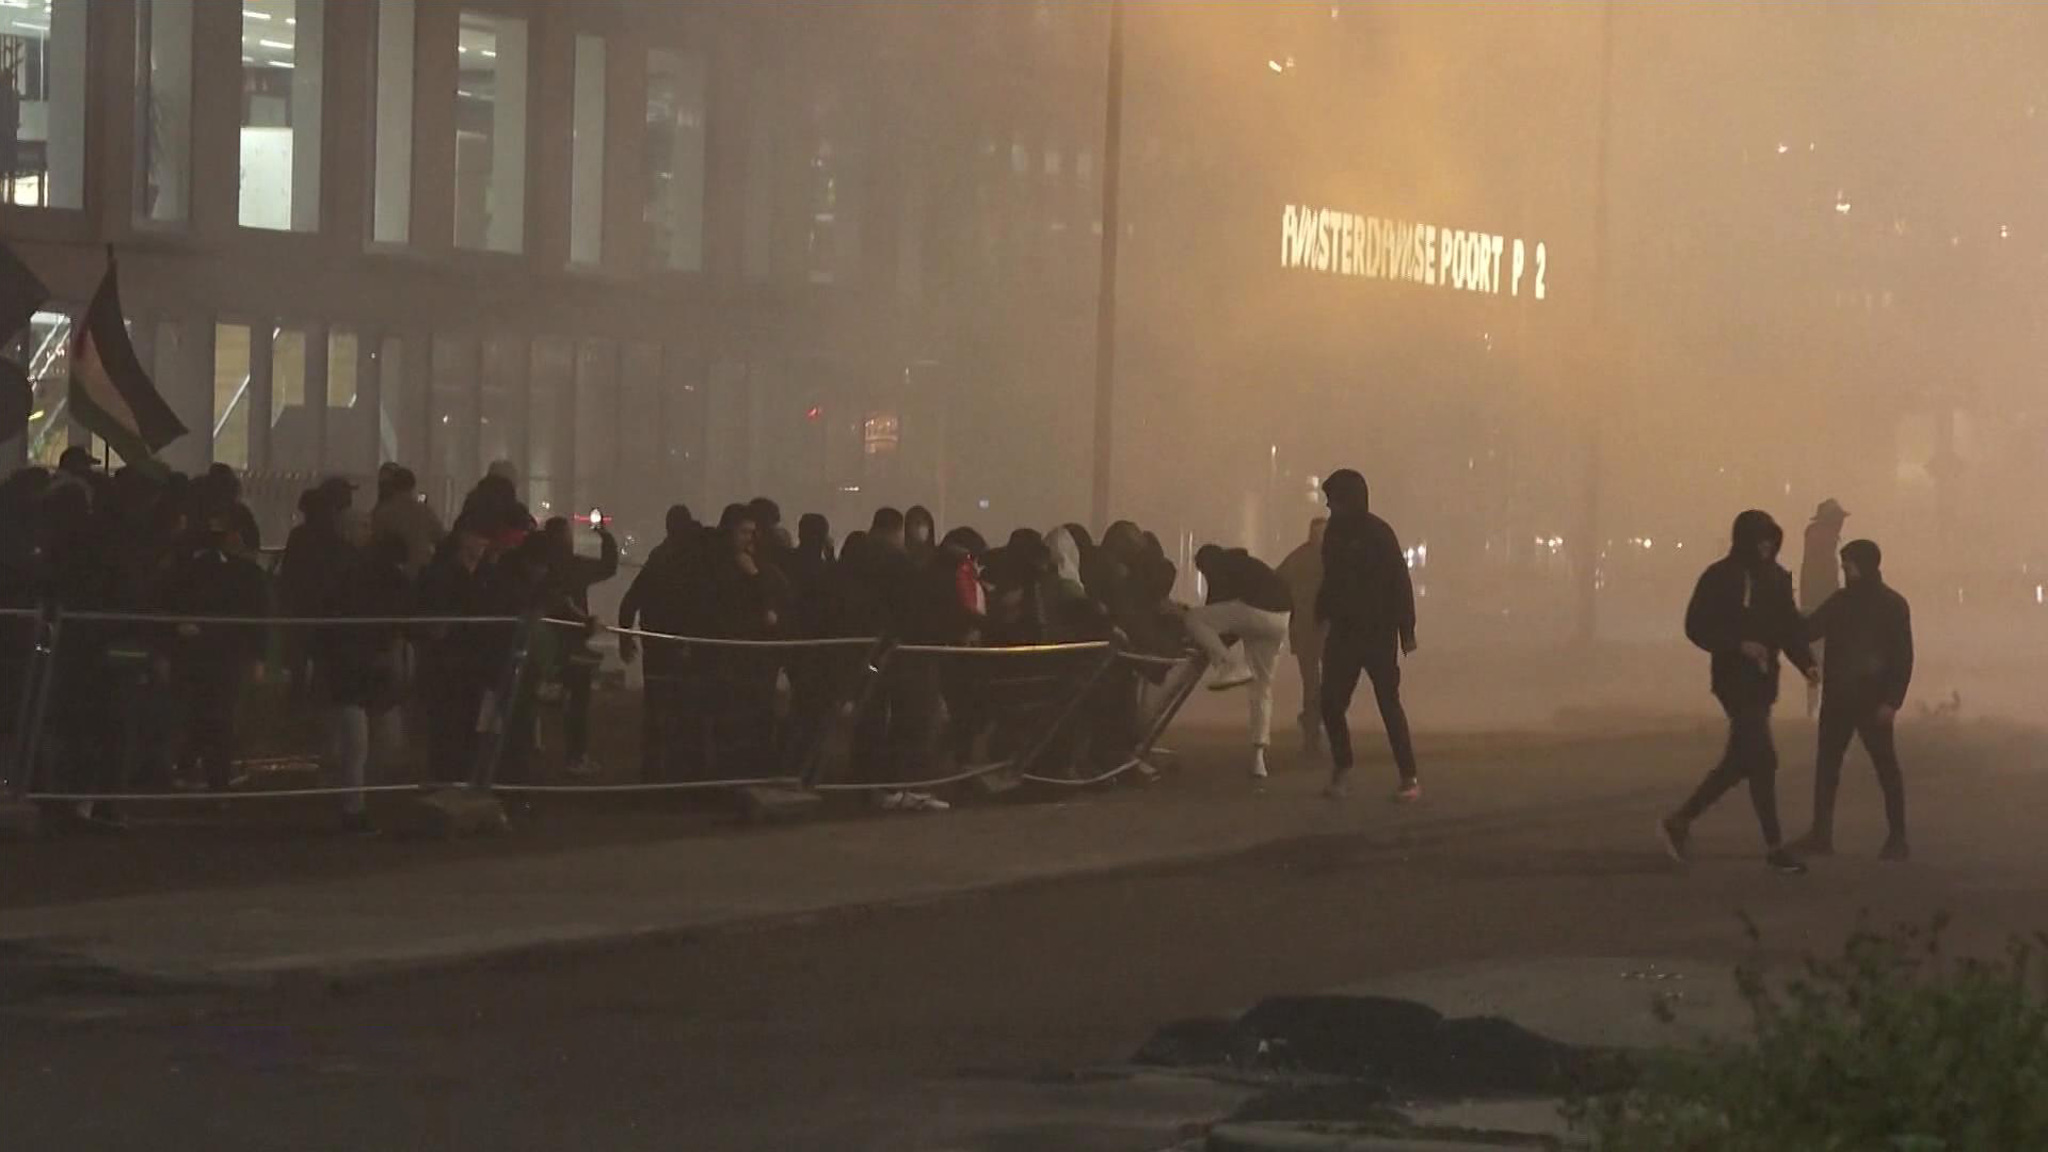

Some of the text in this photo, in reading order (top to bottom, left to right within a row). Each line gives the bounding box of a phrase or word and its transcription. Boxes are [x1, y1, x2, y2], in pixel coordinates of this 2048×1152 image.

[1281, 204, 1546, 299] AMSTERDAMSE POORT P 2
